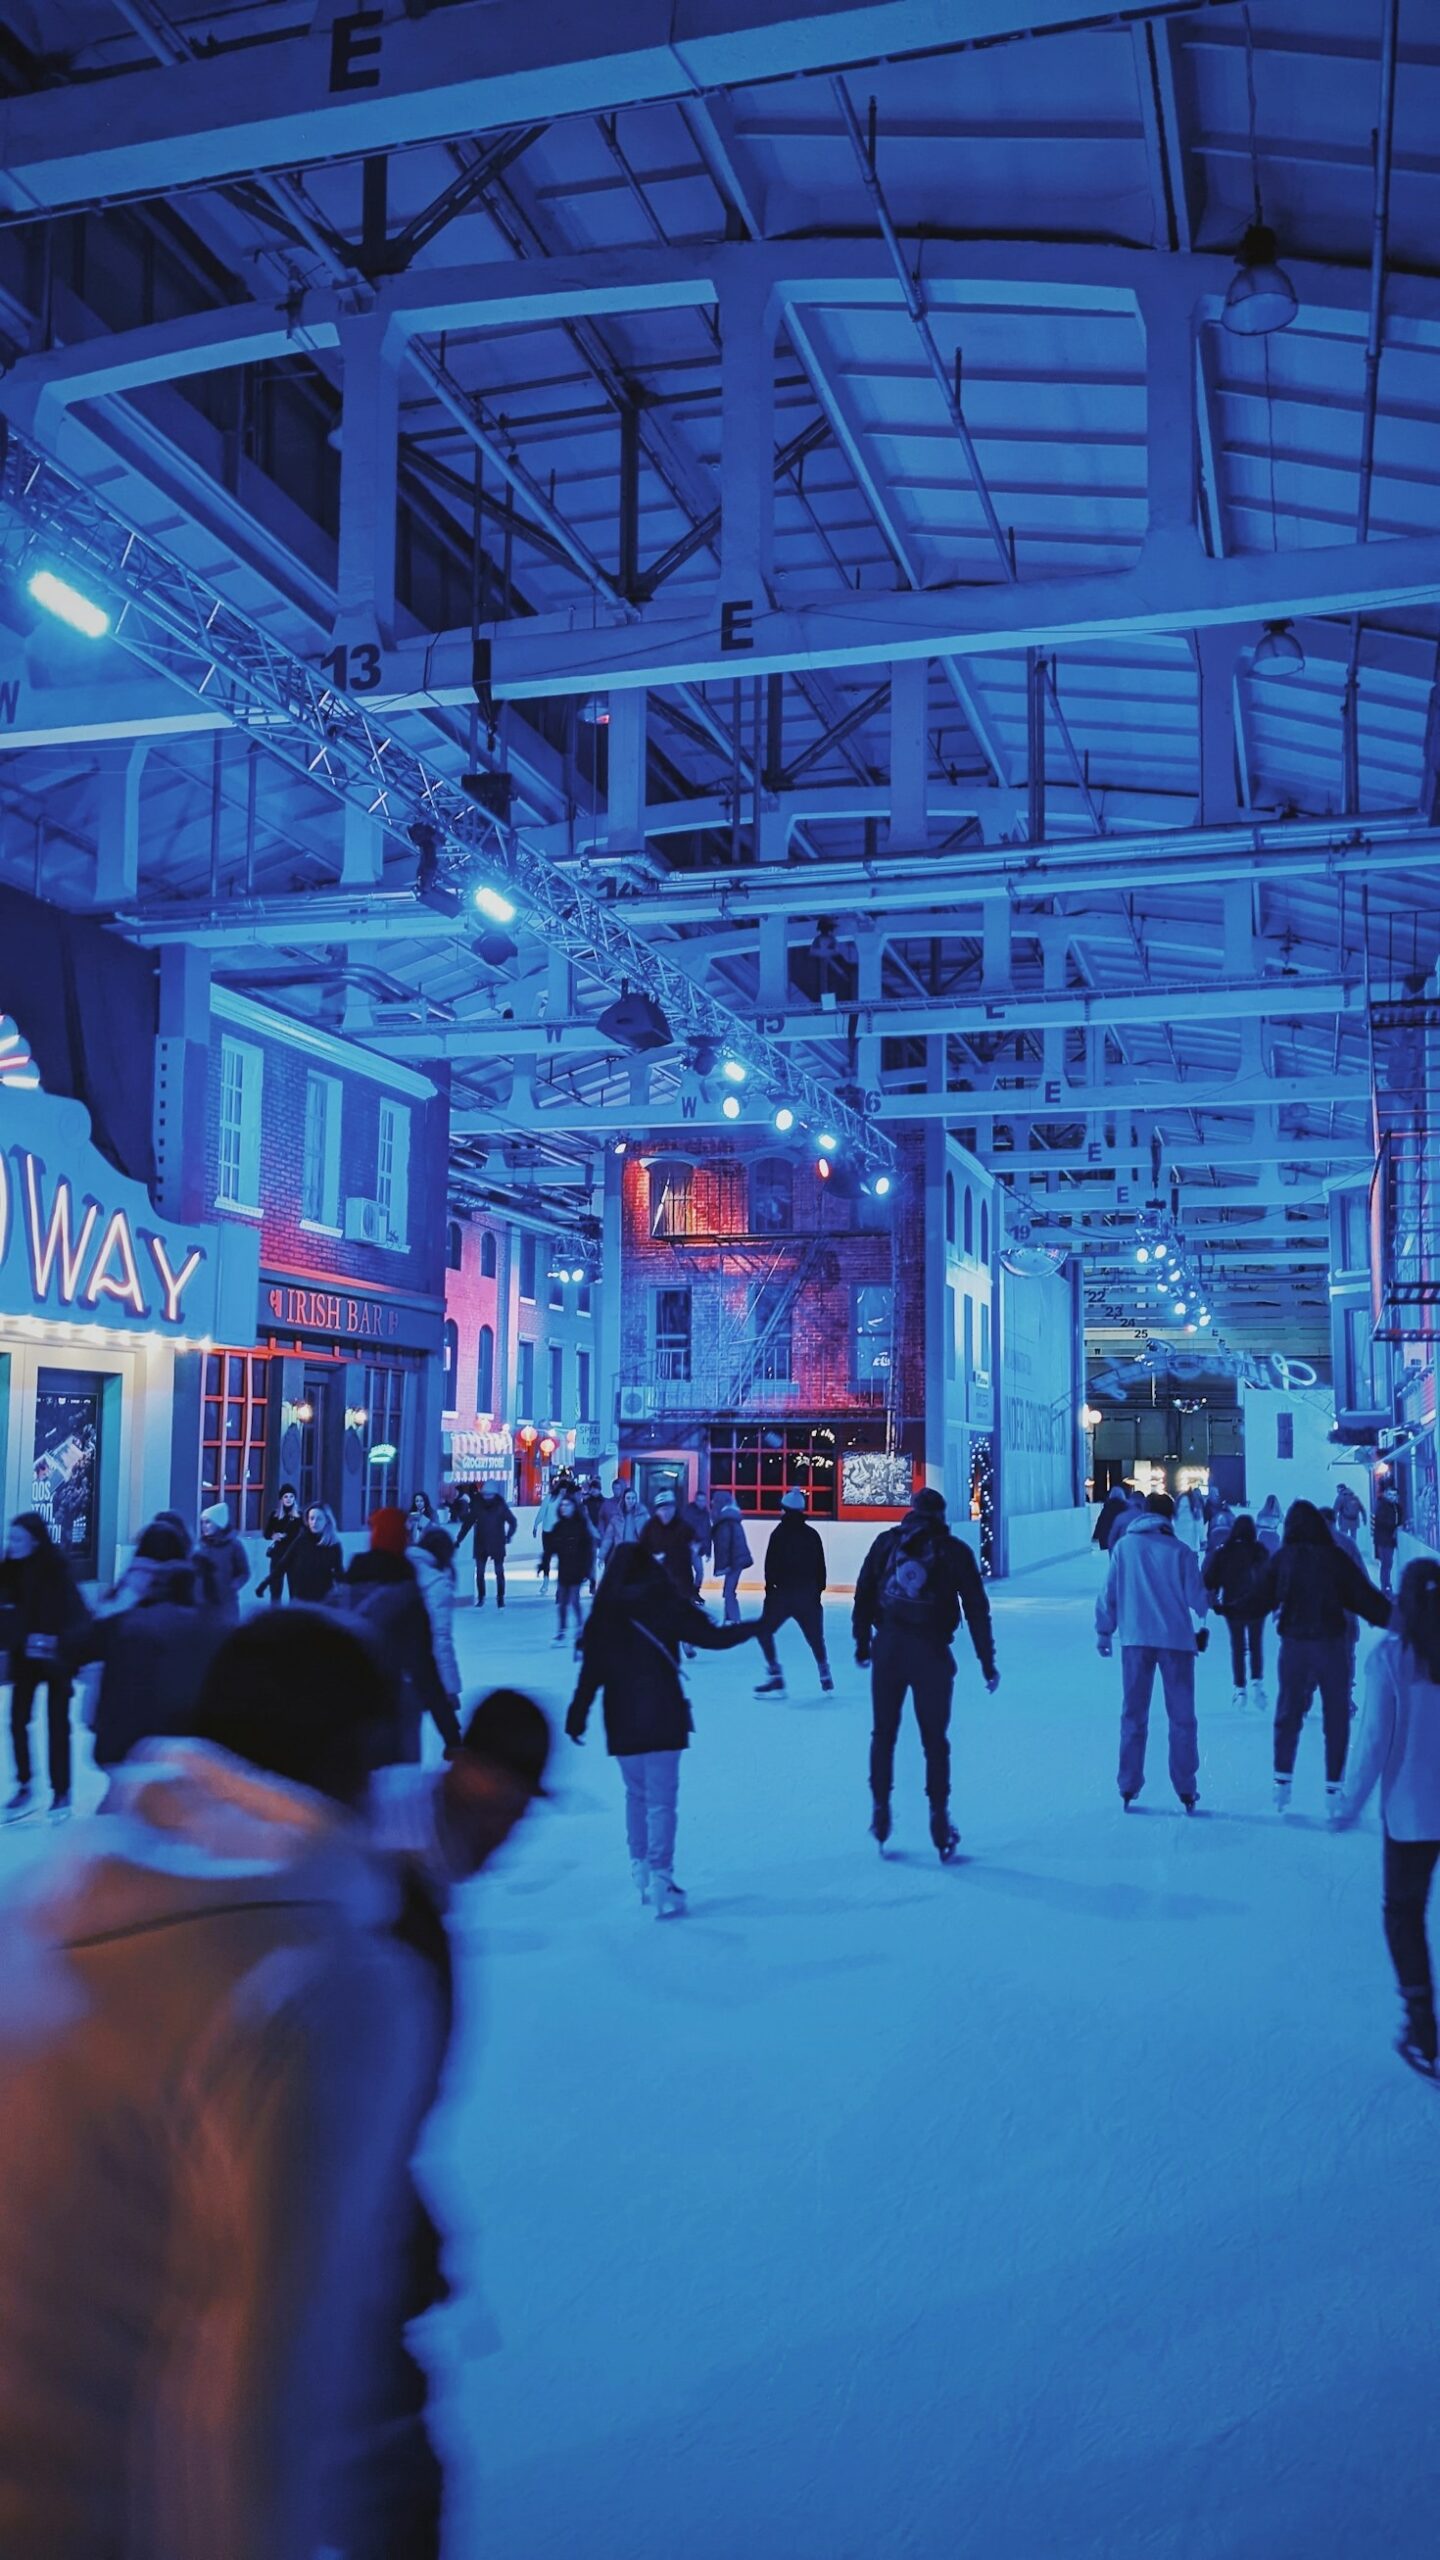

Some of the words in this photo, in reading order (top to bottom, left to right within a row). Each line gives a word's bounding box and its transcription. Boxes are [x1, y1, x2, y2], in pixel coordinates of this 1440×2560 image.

[329, 9, 383, 92] E
[721, 600, 754, 651] E
[320, 643, 382, 691] 13
[1045, 1081, 1062, 1104] E
[681, 1095, 698, 1118] W
[1087, 1142, 1103, 1162] E
[1116, 1186, 1130, 1204] E
[0, 1144, 207, 1324] WAY
[1010, 1225, 1031, 1241] 19
[1087, 1291, 1106, 1303] 22
[287, 1288, 342, 1330] IRISH
[346, 1300, 384, 1336] BAR
[1105, 1306, 1123, 1318] 23
[1134, 1329, 1148, 1339] 25
